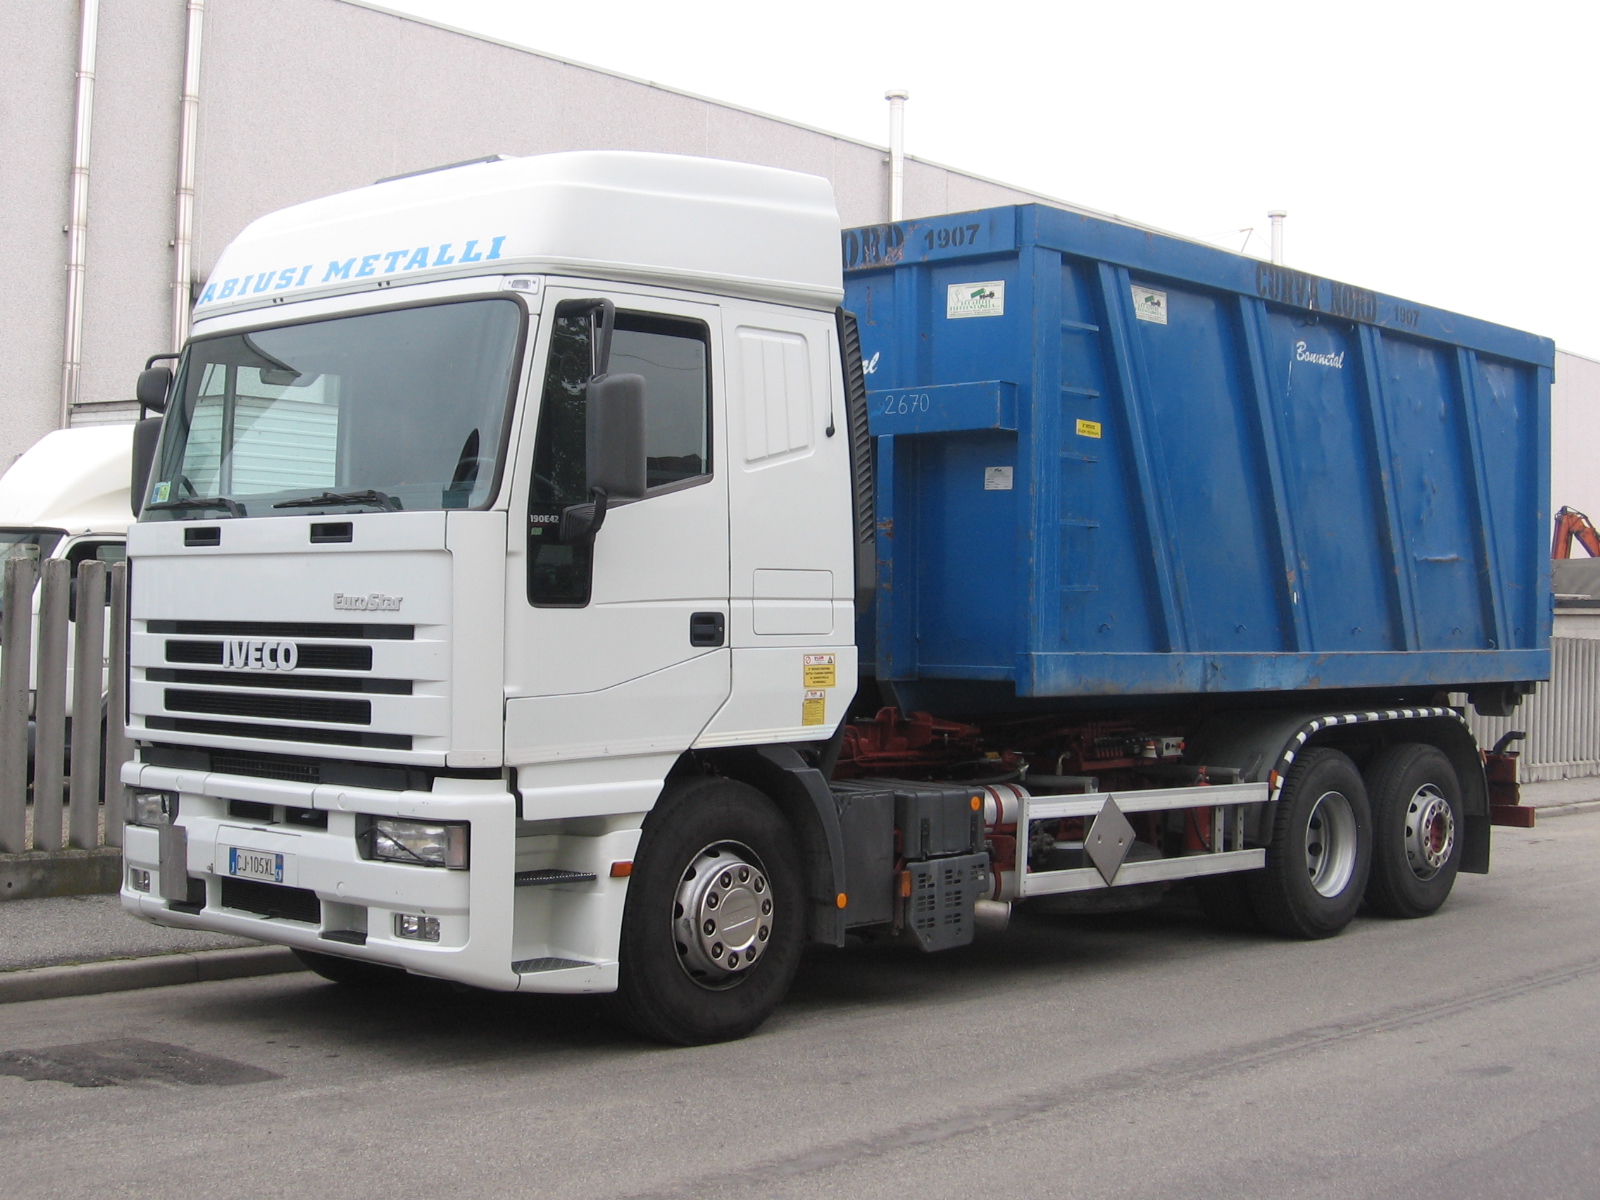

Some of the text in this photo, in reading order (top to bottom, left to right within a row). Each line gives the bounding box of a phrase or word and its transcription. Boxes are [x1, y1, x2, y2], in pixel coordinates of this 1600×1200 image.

[841, 223, 980, 268] ORD 1907
[321, 235, 507, 282] METALLI
[1394, 304, 1420, 328] 1907
[885, 393, 930, 415] 2670
[530, 514, 560, 524] 190E42
[333, 591, 403, 611] EuroStar
[222, 639, 299, 671] IVECO
